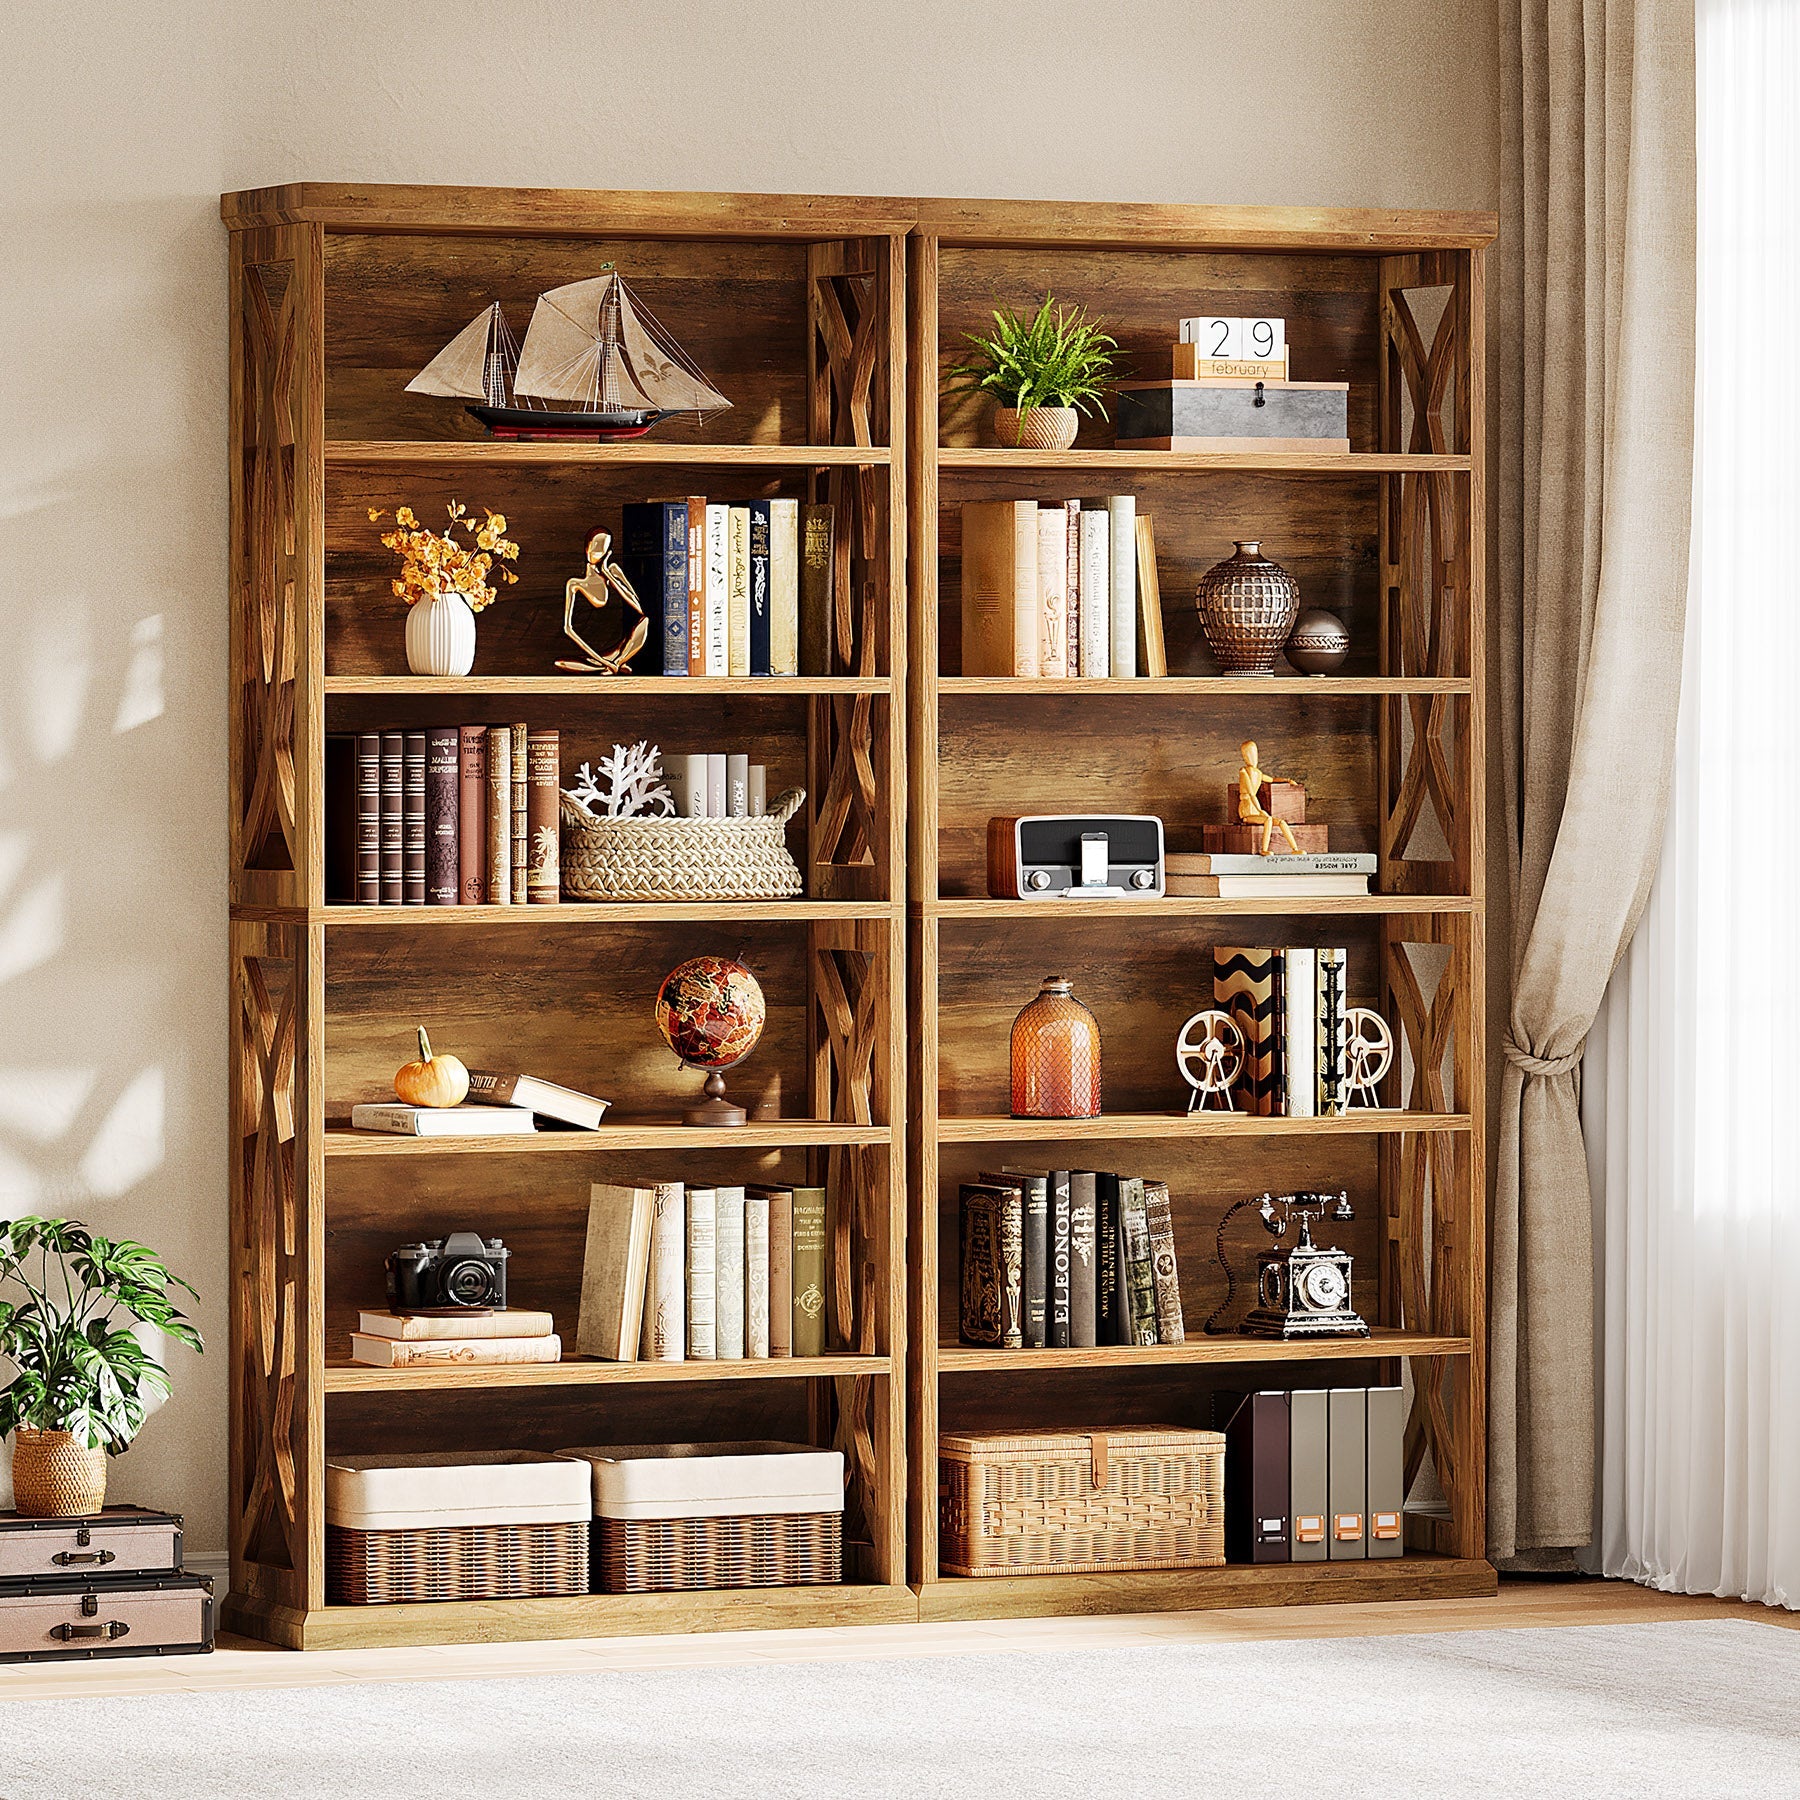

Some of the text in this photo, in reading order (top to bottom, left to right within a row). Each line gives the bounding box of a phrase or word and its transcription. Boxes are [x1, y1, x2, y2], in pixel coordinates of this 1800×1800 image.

[1211, 360, 1269, 378] february
[1054, 1182, 1070, 1325] ELEONORA
[1101, 1199, 1109, 1319] AROUND THE HOUSE
